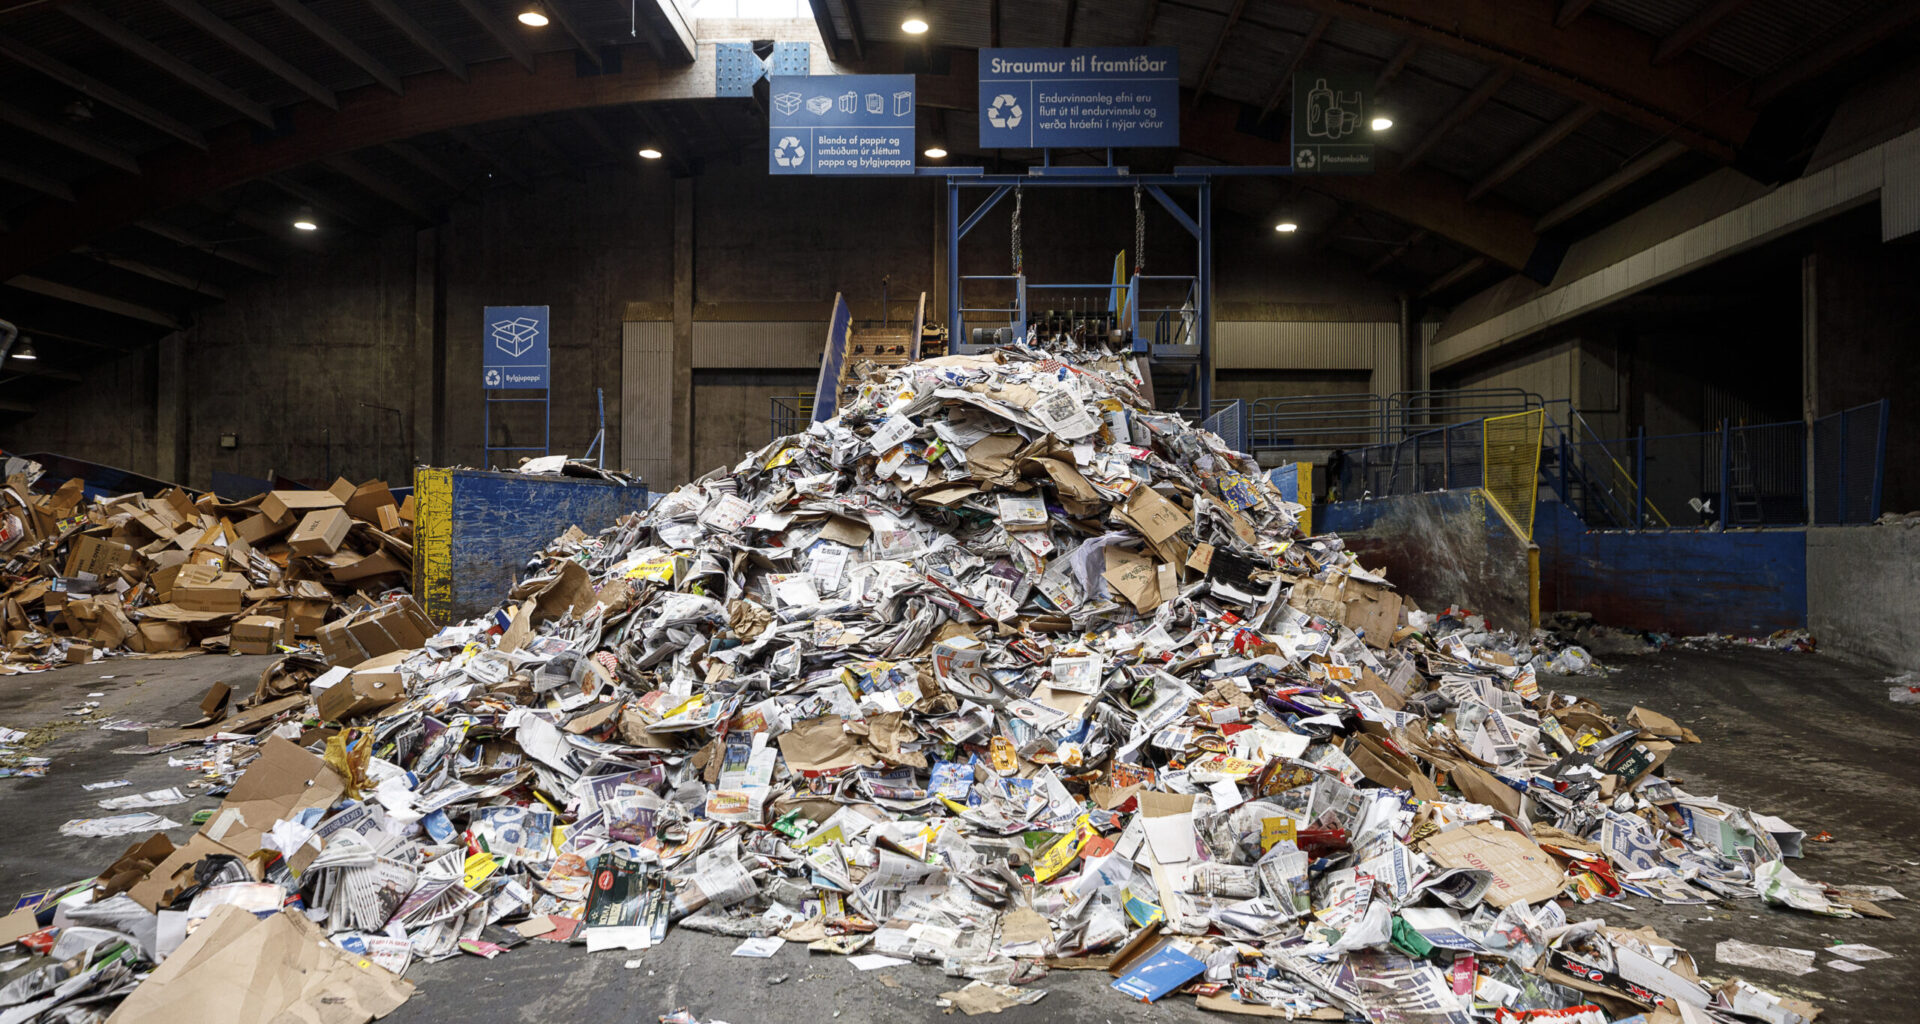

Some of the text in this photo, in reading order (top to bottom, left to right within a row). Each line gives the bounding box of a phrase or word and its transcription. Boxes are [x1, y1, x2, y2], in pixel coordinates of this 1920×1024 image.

[991, 54, 1167, 74] Straumur til framtíðar
[1039, 92, 1152, 105] Endurvinnanleg efni eru
[1039, 105, 1157, 118] flutt út til endurvinnslu og
[1039, 119, 1067, 129] verða
[1069, 118, 1102, 129] hráefni
[1112, 118, 1136, 132] nýjar
[1139, 119, 1163, 129] vörur
[818, 136, 847, 145] Blanda
[849, 136, 858, 144] af
[888, 137, 900, 147] og
[818, 146, 900, 155] umbúðum úr sléttum
[818, 157, 911, 169] pappa og bylgjupappa
[505, 373, 541, 384] Bylgjupappi
[1616, 756, 1636, 773] ROYAL
